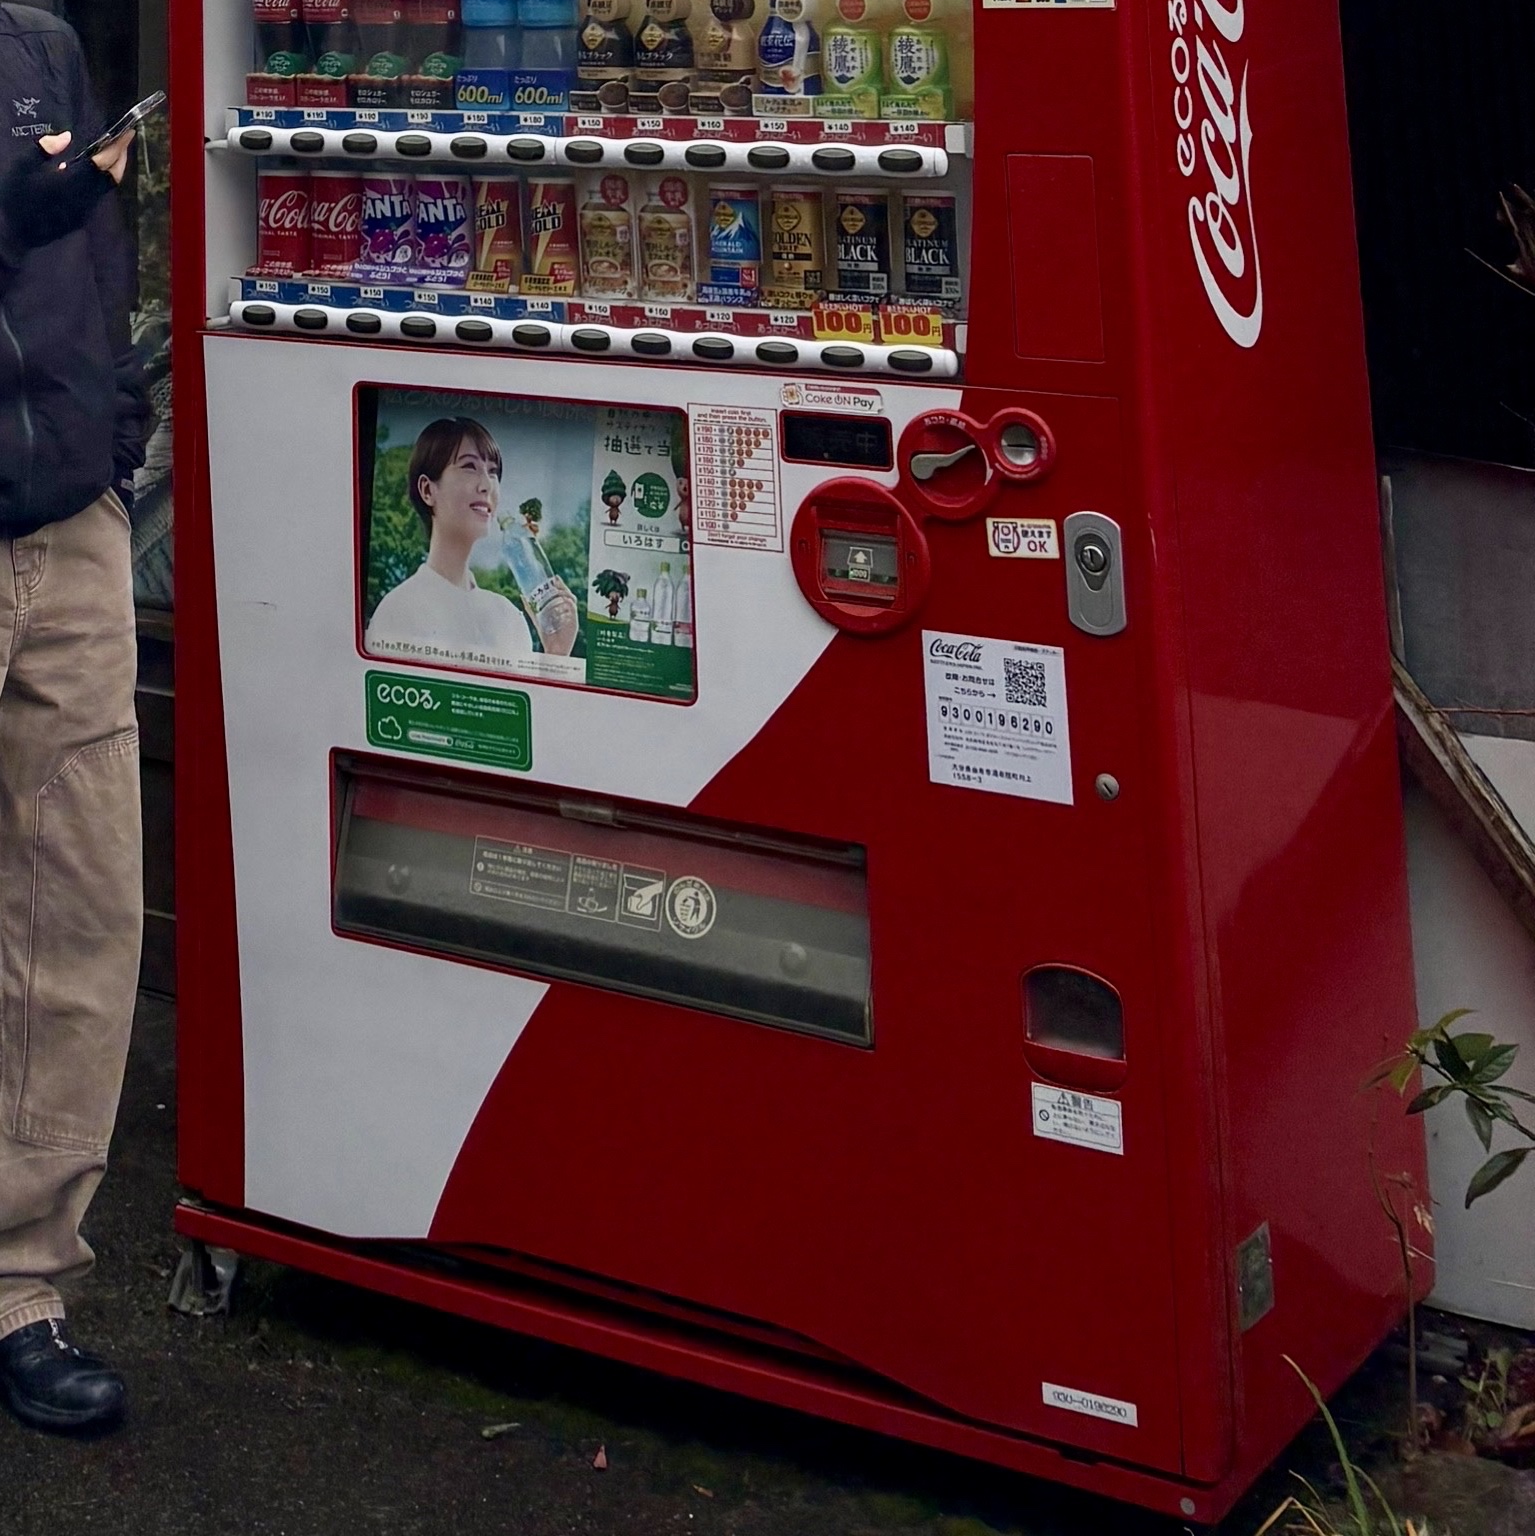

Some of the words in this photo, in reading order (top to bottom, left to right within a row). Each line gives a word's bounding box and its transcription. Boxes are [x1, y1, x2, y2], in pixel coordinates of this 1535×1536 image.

[832, 34, 850, 74] 綾鷹
[897, 34, 916, 74] 綾鷹
[514, 75, 537, 84] たっぷり
[457, 85, 503, 104] 600ml
[514, 86, 563, 105] 600ml
[906, 248, 950, 265] BLACK
[815, 311, 872, 334] 100円
[882, 314, 941, 337] 100円
[805, 393, 832, 404] Coke
[834, 394, 851, 405] ON
[853, 396, 874, 410] Pay
[622, 534, 665, 549] いろはす
[1027, 540, 1048, 553] OK
[929, 638, 983, 663] Coca-Cola
[940, 705, 1053, 735] 9300196290
